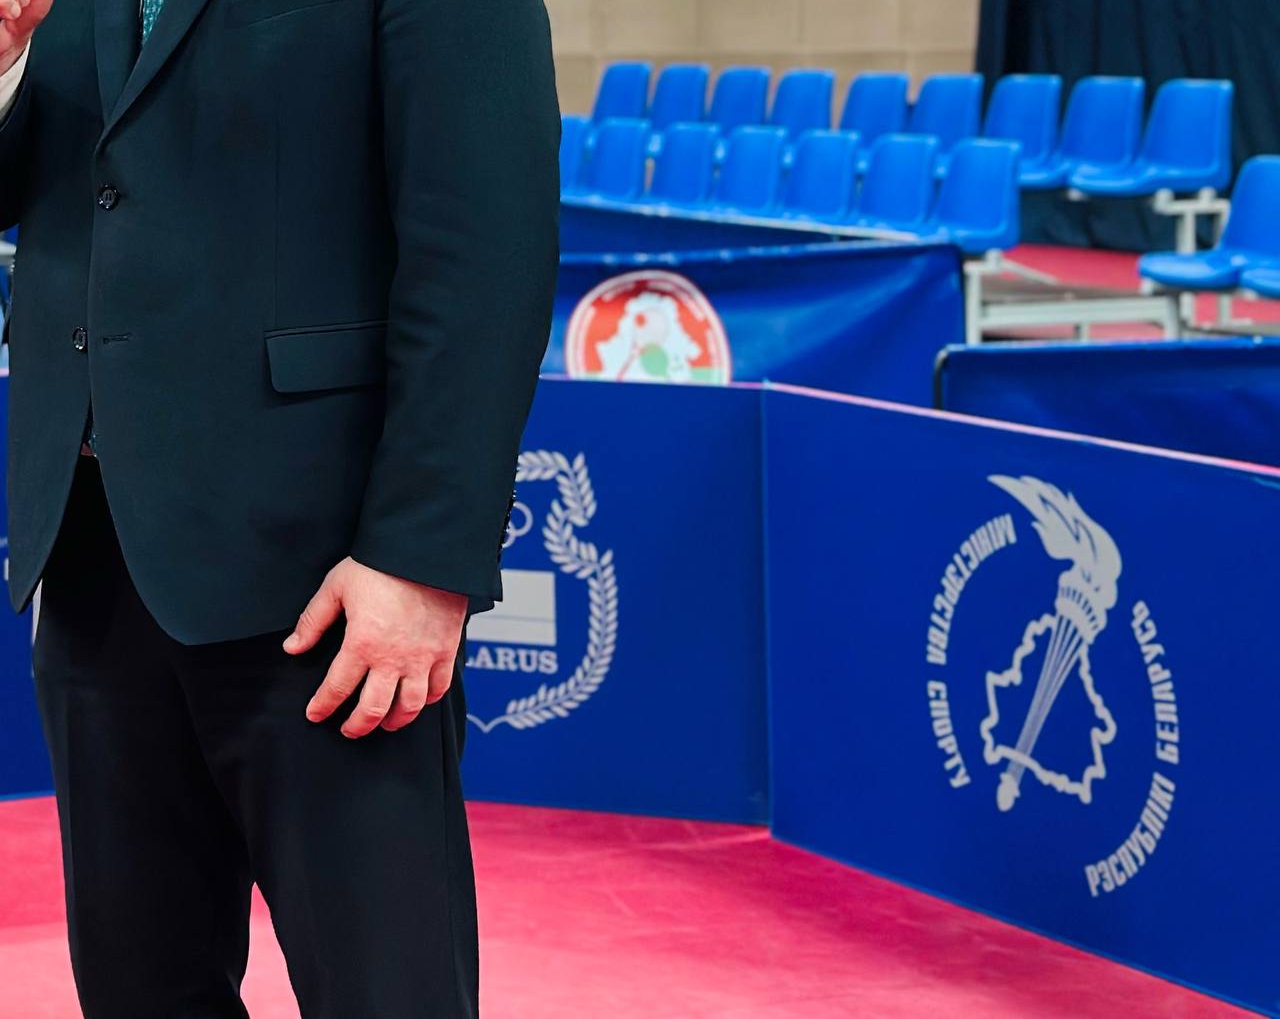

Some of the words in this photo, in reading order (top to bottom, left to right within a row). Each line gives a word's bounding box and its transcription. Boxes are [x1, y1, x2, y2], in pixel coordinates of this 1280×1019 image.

[926, 513, 1017, 665] МІНІСТЭРСТВА
[927, 680, 971, 789] СПОРТУ
[1084, 772, 1176, 898] РЭСПУБЛІКІ
[1131, 600, 1179, 765] БЕЛАРУСЬ
